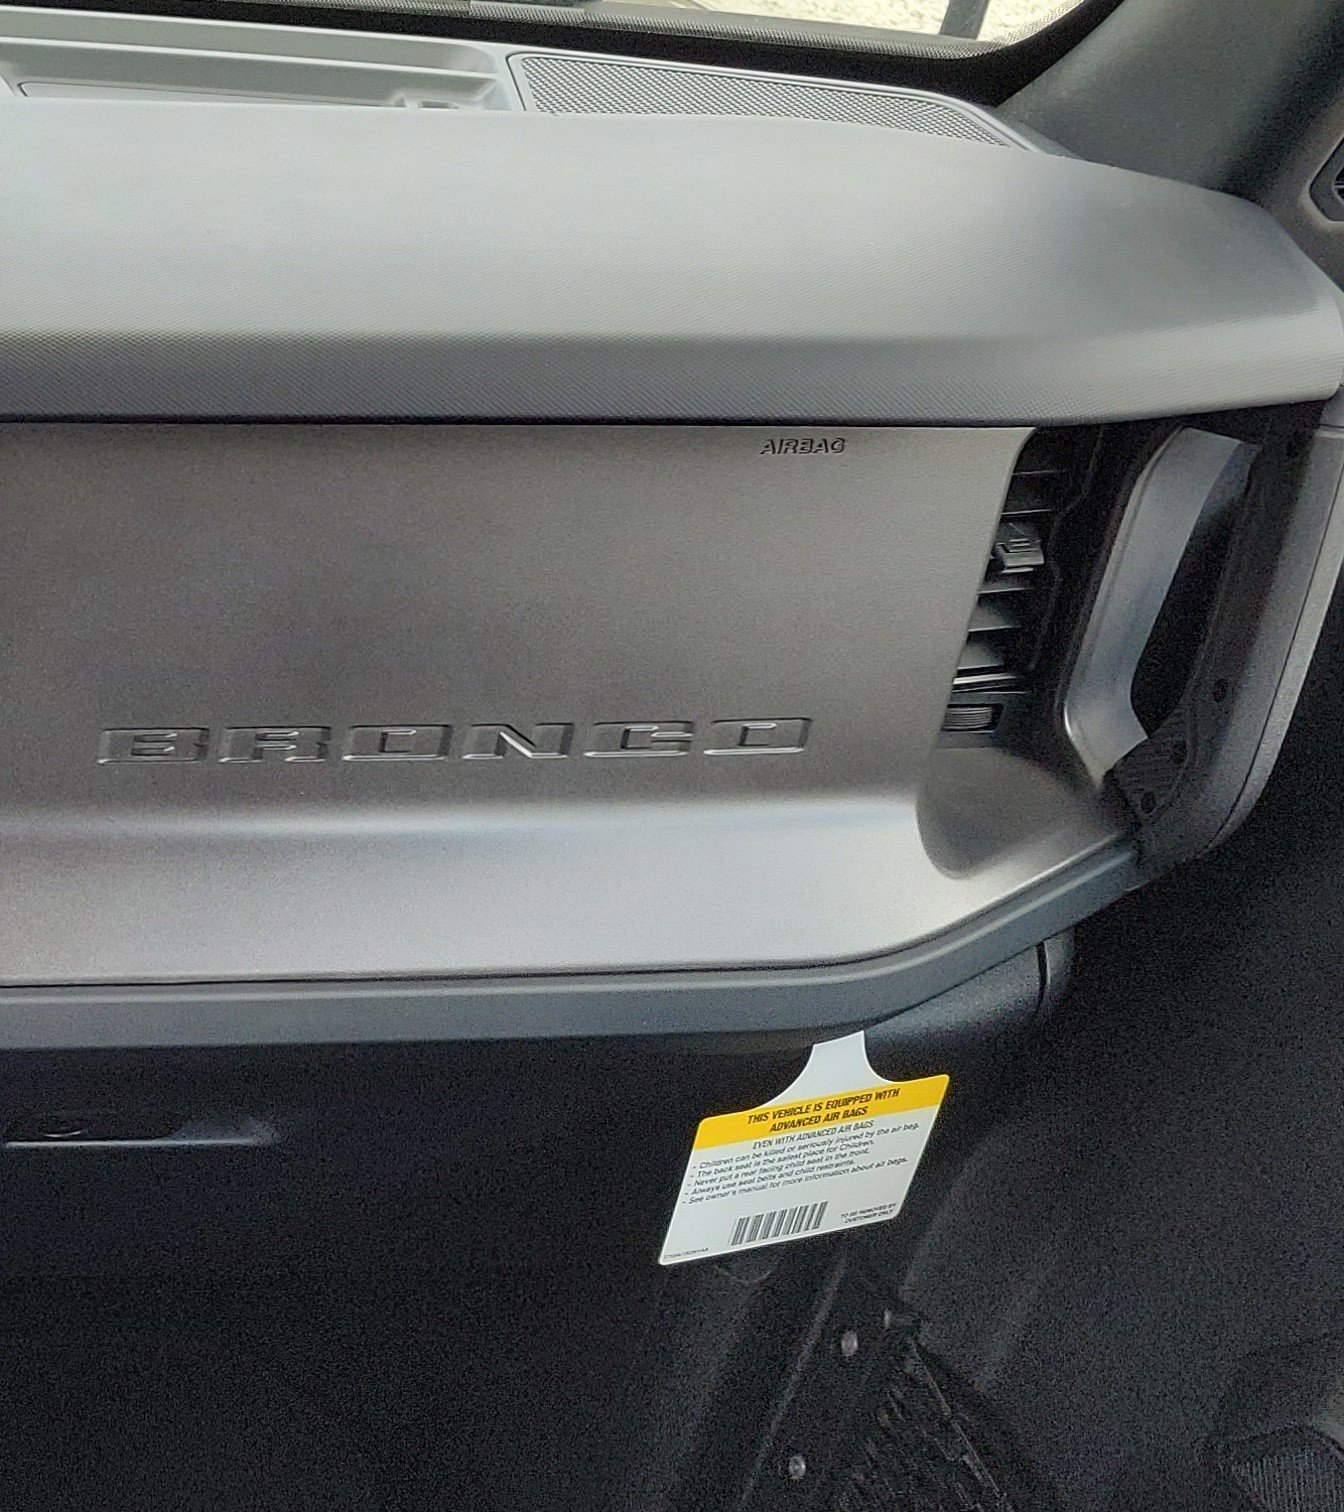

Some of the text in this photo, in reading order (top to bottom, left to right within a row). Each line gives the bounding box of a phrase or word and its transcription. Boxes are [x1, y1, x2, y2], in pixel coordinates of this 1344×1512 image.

[759, 436, 847, 457] AIRBAG
[96, 715, 814, 765] BRONCO
[746, 1087, 901, 1124] THIS VEHICLE IS EQUIPPED WITH
[768, 1105, 869, 1132] ADVANCED AIR BAGS
